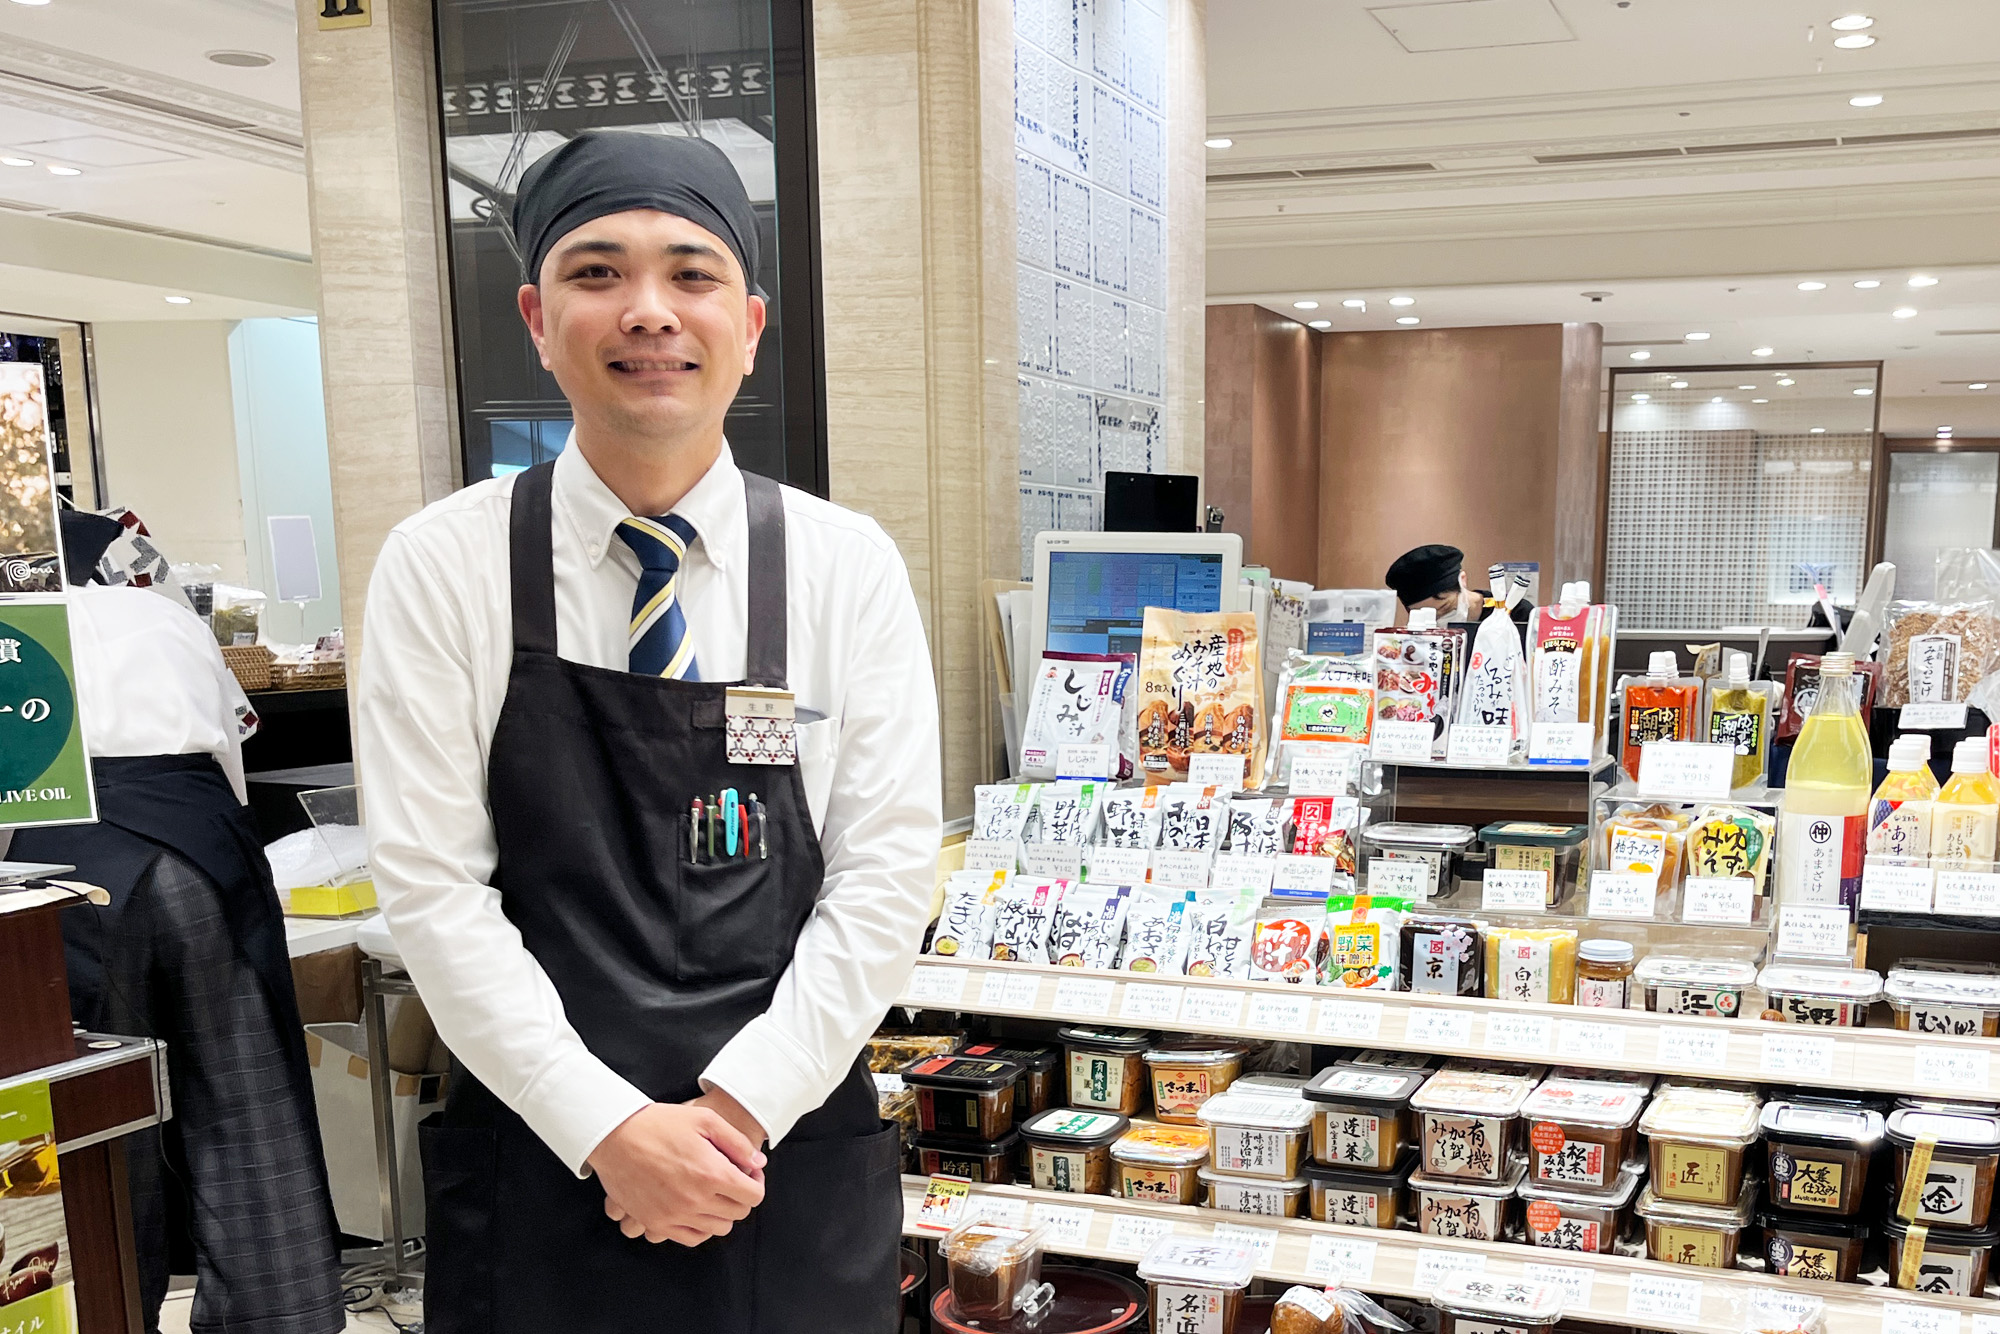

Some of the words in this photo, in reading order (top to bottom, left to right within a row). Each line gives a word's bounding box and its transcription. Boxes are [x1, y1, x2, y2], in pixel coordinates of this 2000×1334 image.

[1187, 640, 1208, 692] みそ汁
[1205, 634, 1226, 689] 産地の
[1145, 681, 1169, 693] 8食入
[1548, 657, 1568, 715] 酢みそ
[748, 702, 775, 712] 生野
[1482, 707, 1509, 725] 味
[1401, 741, 1422, 750] ¥389
[40, 788, 72, 801] OIL
[1614, 839, 1660, 860] 柚子みそ
[1702, 827, 1723, 874] みそ
[1721, 827, 1747, 875] ゆず
[1053, 864, 1073, 873] ¥142
[1180, 872, 1200, 880] ¥162
[1380, 874, 1414, 883] 八丁味噌
[1812, 847, 1825, 892] あまざけ
[1396, 884, 1418, 892] ¥594
[1513, 890, 1536, 899] ¥972
[948, 891, 977, 936] たまご
[1337, 934, 1374, 952] 野菜
[1812, 931, 1837, 941] ¥972
[1335, 953, 1373, 965] 味噌汁
[1426, 956, 1444, 979] 京
[1514, 966, 1532, 1001] 白味
[1437, 1028, 1460, 1038] ¥789
[1094, 1060, 1105, 1100] 有機味噌
[1949, 1069, 1977, 1079] ¥389
[1164, 1080, 1200, 1094] さつま
[1431, 1118, 1448, 1158] みそ
[1448, 1126, 1467, 1162] 加賀
[1466, 1119, 1492, 1175] 有機
[1239, 1131, 1253, 1170] 清治郎
[1566, 1142, 1587, 1175] 松本
[942, 1160, 970, 1176] 吟香
[1543, 1154, 1555, 1179] みそ
[1555, 1150, 1566, 1179] 育ち
[1680, 1161, 1704, 1185] 匠
[1794, 1163, 1831, 1185] 大寒
[1132, 1179, 1170, 1193] さつま
[1801, 1181, 1838, 1196] 仕込み
[1427, 1197, 1443, 1235] みそ
[1444, 1204, 1463, 1238] 加賀
[1540, 1231, 1552, 1249] み
[1552, 1228, 1563, 1250] 育
[1562, 1219, 1583, 1251] 松本
[1676, 1243, 1700, 1266] 匠
[1791, 1249, 1827, 1269] 大寒
